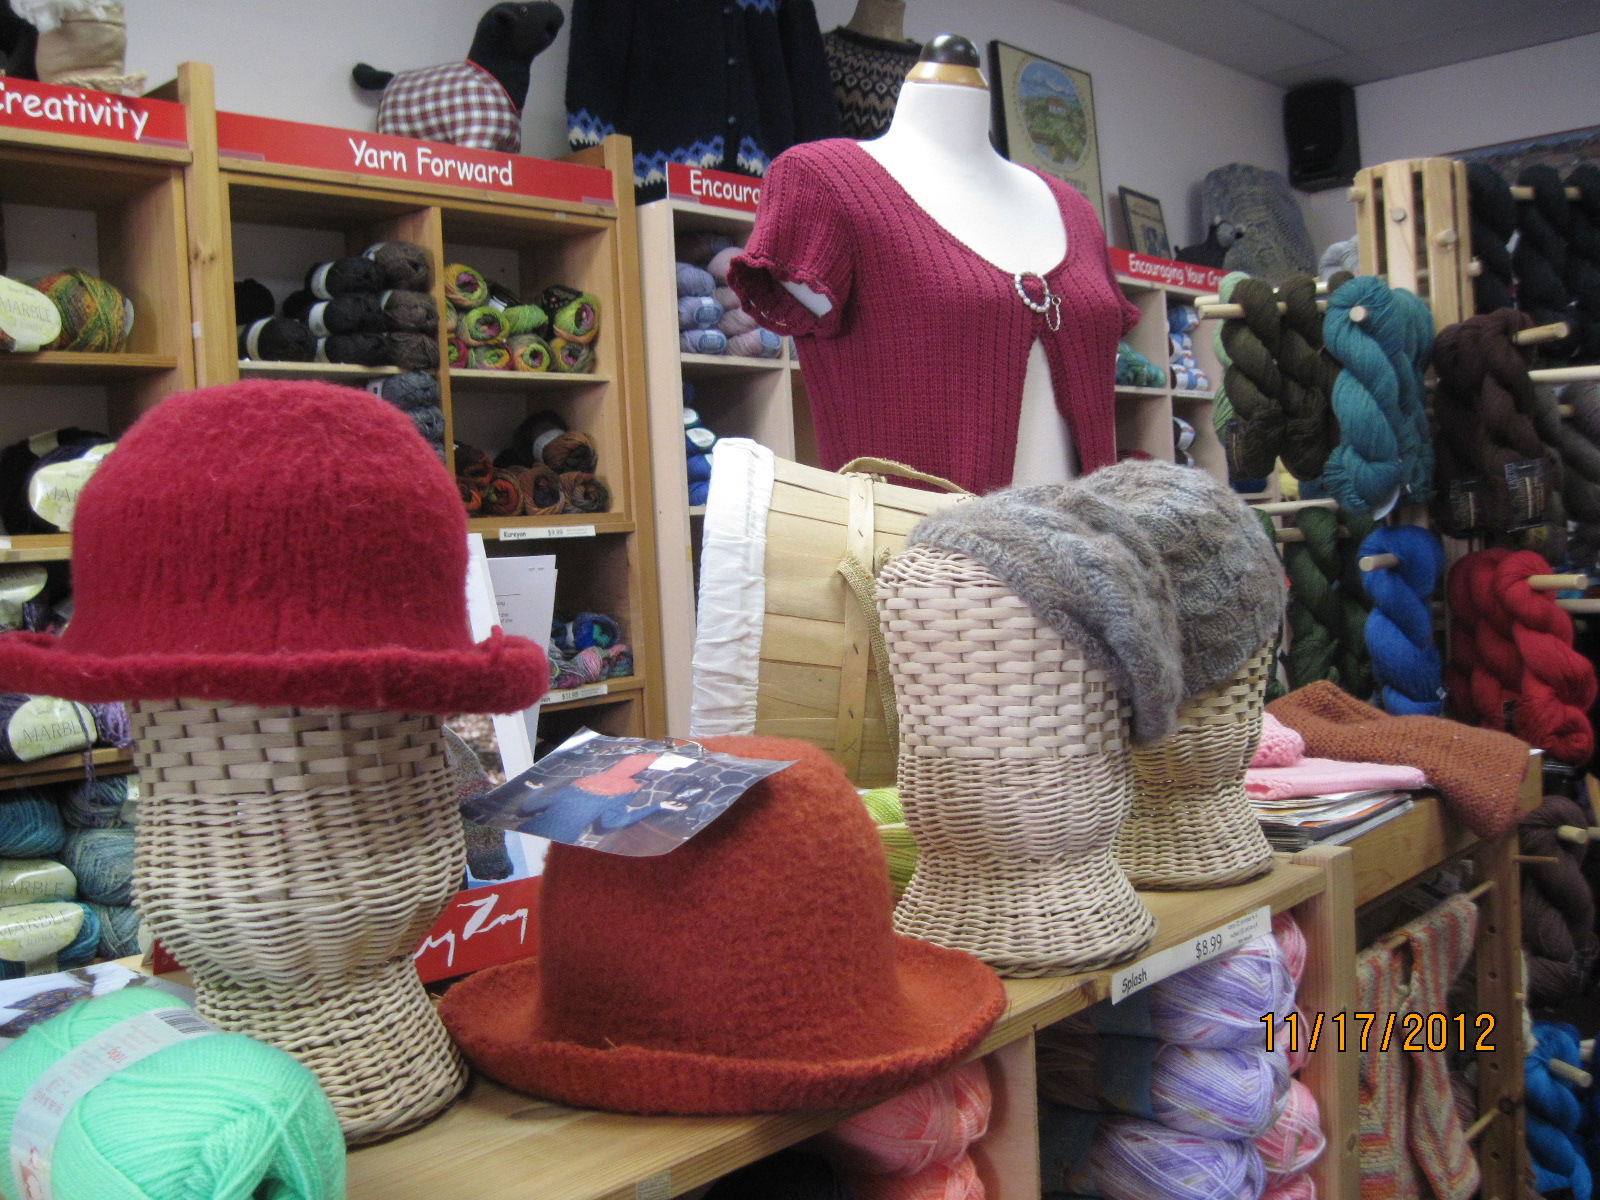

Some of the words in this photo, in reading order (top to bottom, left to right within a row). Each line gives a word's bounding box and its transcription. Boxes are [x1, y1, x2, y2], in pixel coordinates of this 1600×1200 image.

[349, 137, 407, 173] Yarn
[417, 146, 513, 187] Forward
[1128, 253, 1184, 286] Encouraging
[1184, 265, 1206, 285] Your
[0, 879, 64, 896] ARBLE
[1121, 968, 1148, 995] Splash
[1195, 933, 1223, 960] $8.99
